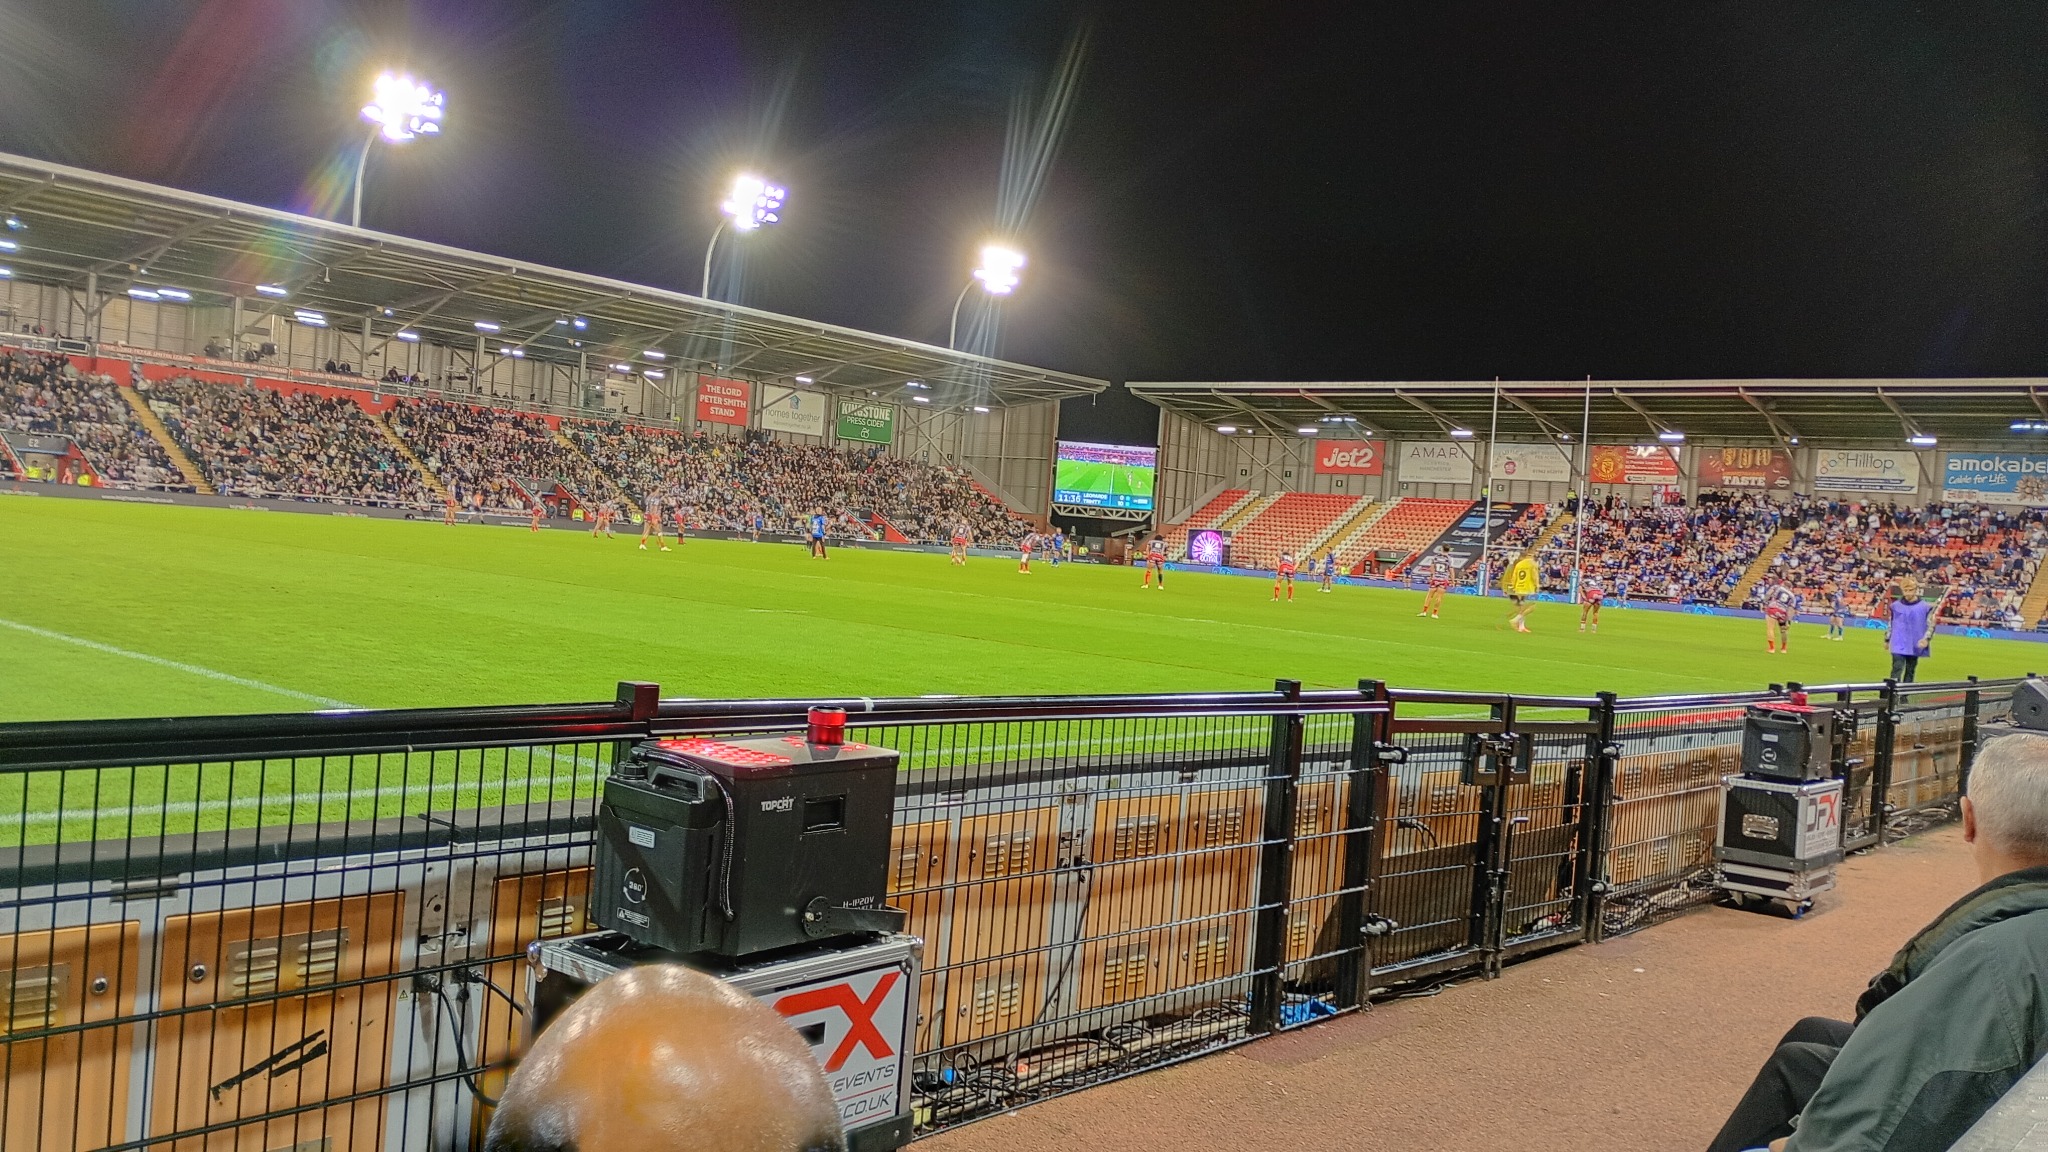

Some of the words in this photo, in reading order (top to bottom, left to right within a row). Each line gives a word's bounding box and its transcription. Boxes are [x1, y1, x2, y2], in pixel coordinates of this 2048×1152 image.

[705, 384, 721, 394] THE
[722, 386, 742, 397] LORD
[699, 394, 723, 405] PETER
[723, 398, 747, 408] SMITH
[710, 406, 735, 417] STAND
[791, 411, 821, 423] together
[841, 402, 891, 421] KINGSTONE
[846, 416, 865, 426] PRESS
[866, 419, 884, 428] CIDER
[28, 438, 39, 448] E2
[1323, 447, 1373, 468] Jet2
[1846, 453, 1894, 473] Hilltop
[1948, 456, 2048, 473] amokabe
[1722, 475, 1766, 486] TASTE
[1973, 474, 1988, 484] for
[1988, 473, 2008, 484] Life
[1058, 494, 1081, 503] 11:36
[1519, 570, 1526, 580] 9
[760, 797, 794, 812] TOPCAT
[832, 1063, 896, 1093] EVENTS
[842, 1091, 893, 1119] CO.UK
